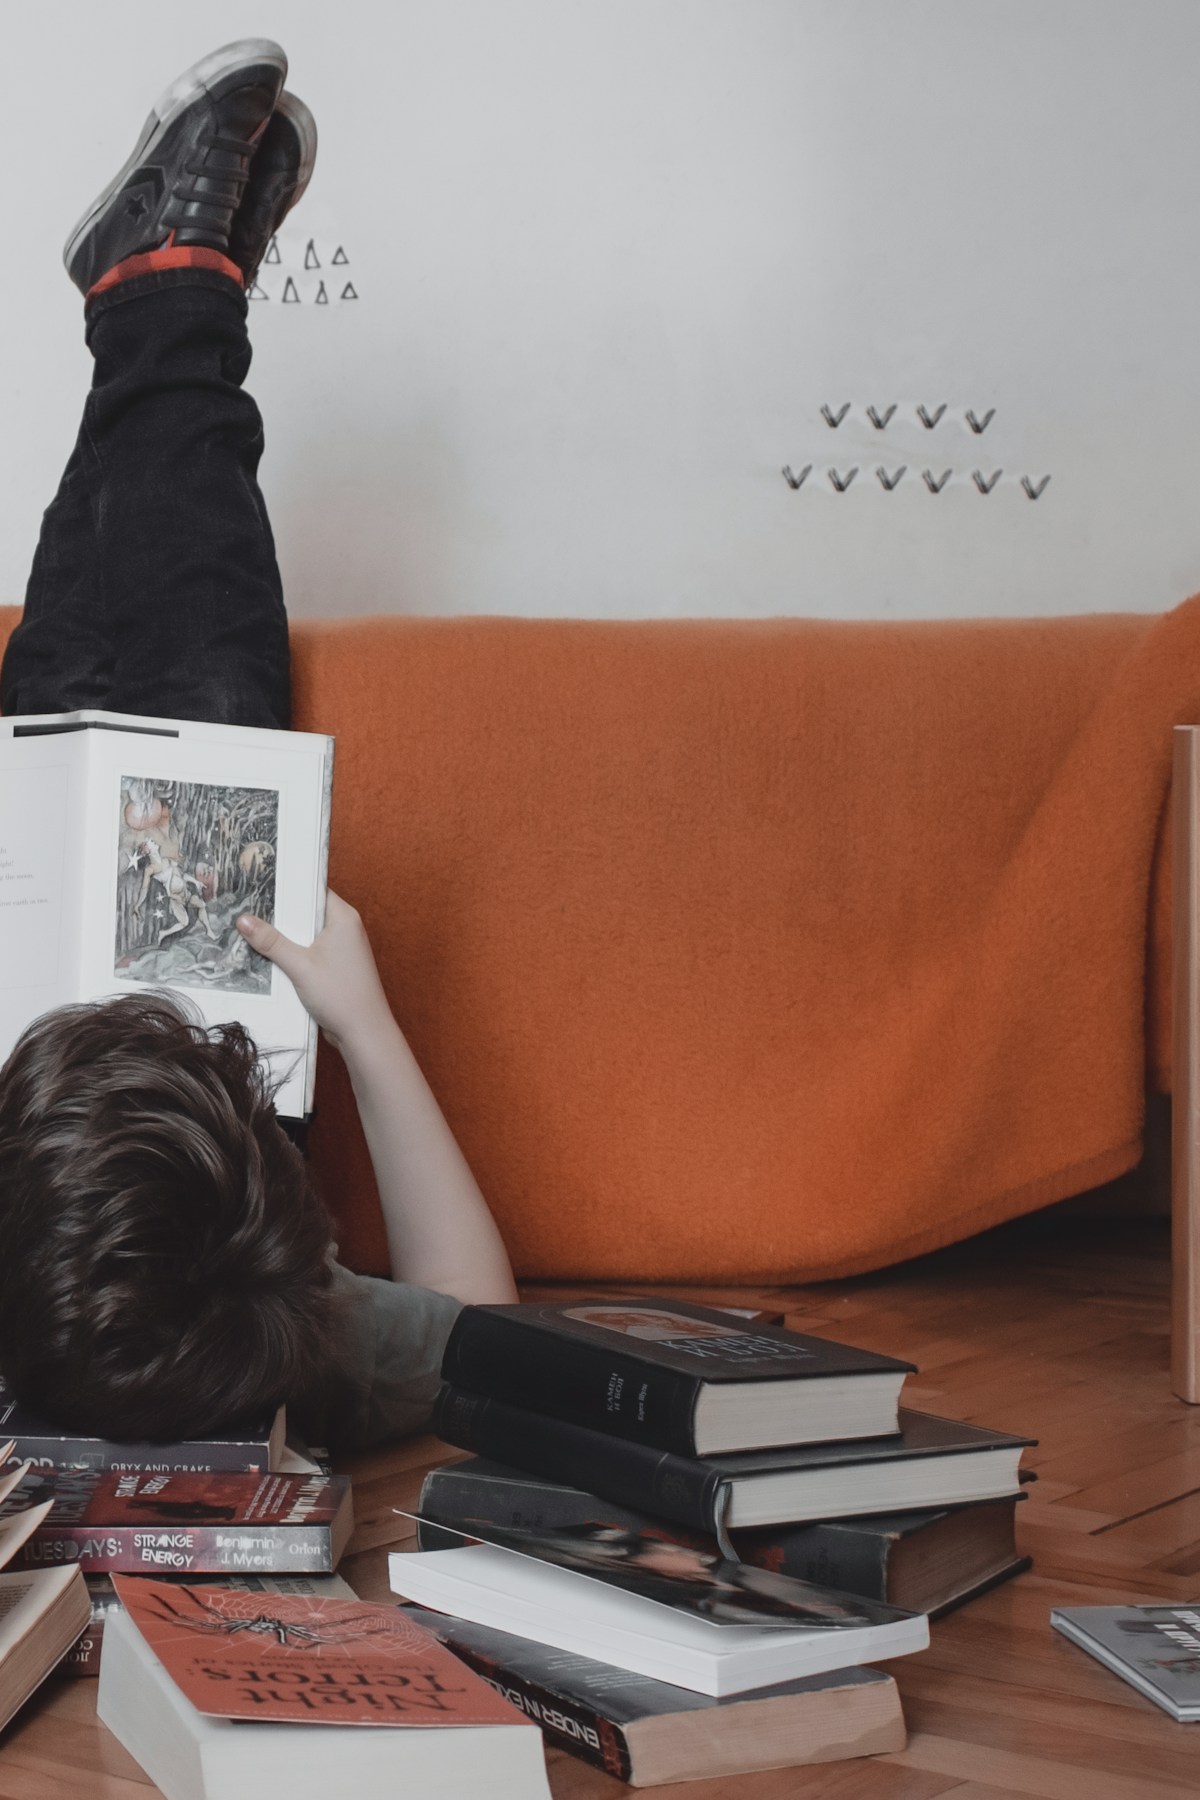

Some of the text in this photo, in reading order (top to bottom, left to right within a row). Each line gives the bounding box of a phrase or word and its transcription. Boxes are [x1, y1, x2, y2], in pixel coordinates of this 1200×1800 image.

[656, 1335, 781, 1350] КАМЕН
[607, 1372, 619, 1412] КАМЕН
[614, 1377, 625, 1400] БОЛ
[144, 1464, 170, 1472] AND
[115, 1474, 141, 1498] STRANGE
[134, 1533, 195, 1548] STRANGE
[216, 1535, 275, 1549] Benjamin
[288, 1542, 321, 1556] Orion
[141, 1550, 195, 1568] ENERGY
[220, 1552, 274, 1567] J. Myers
[237, 1686, 456, 1711] Night
[480, 1674, 601, 1750] ENDER IN EXIL
